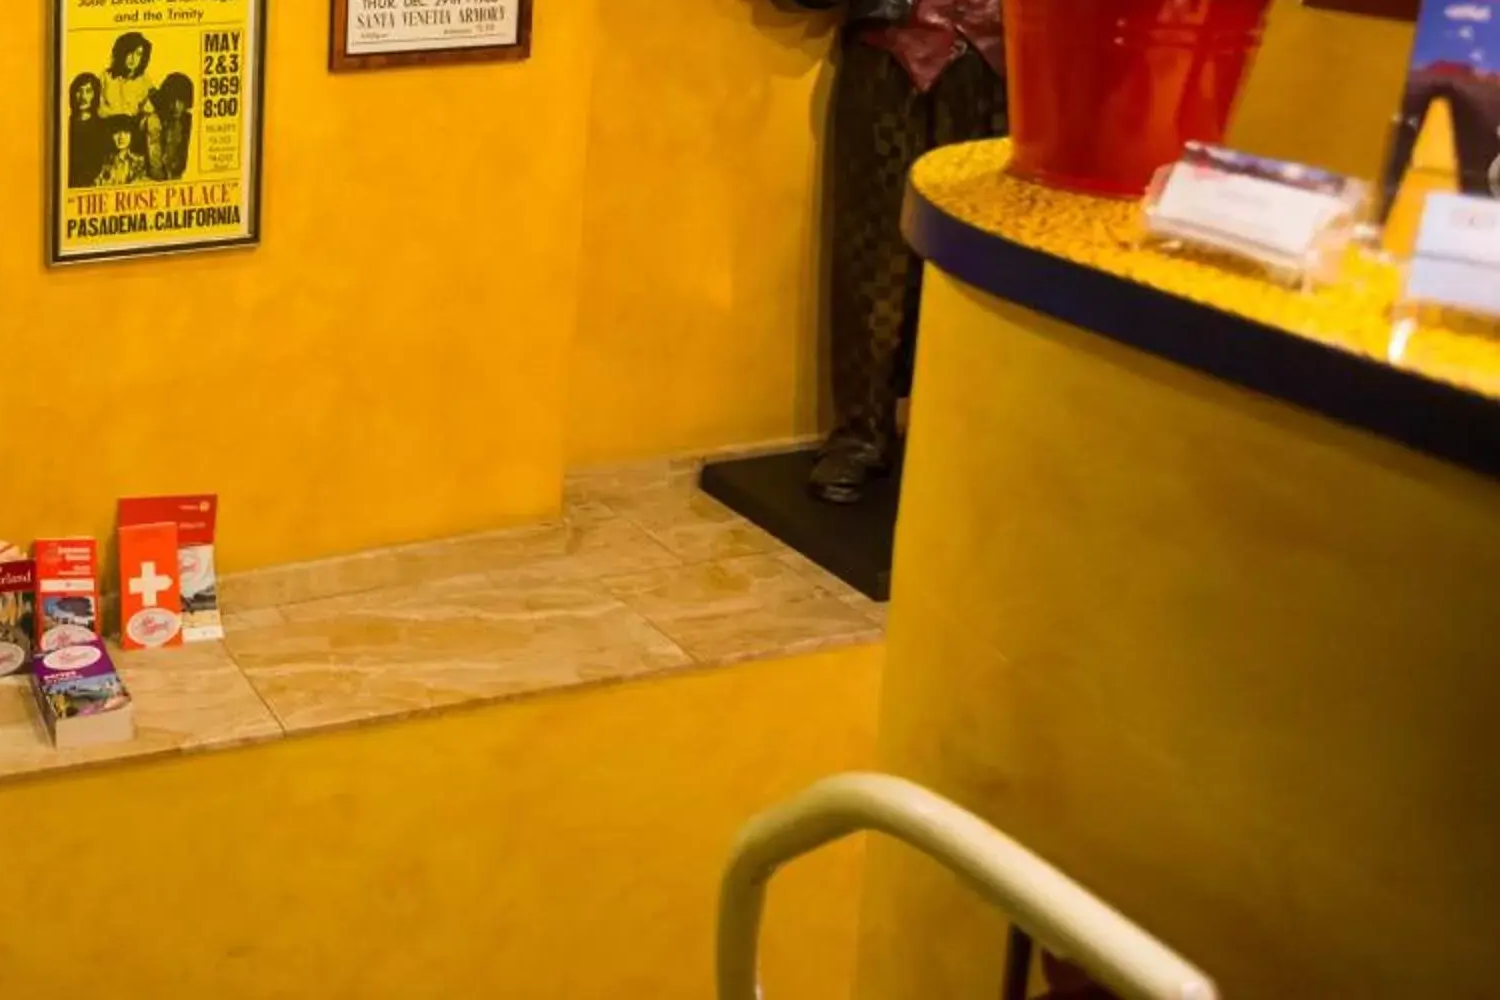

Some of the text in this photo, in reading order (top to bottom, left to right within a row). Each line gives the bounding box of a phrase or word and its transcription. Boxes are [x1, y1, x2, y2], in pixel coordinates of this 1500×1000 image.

[114, 7, 204, 23] and the Trinity
[357, 12, 395, 30] SANTA
[204, 32, 241, 53] MAY
[203, 77, 240, 97] 1969
[203, 98, 238, 118] 8:00
[115, 187, 160, 212] ROSE
